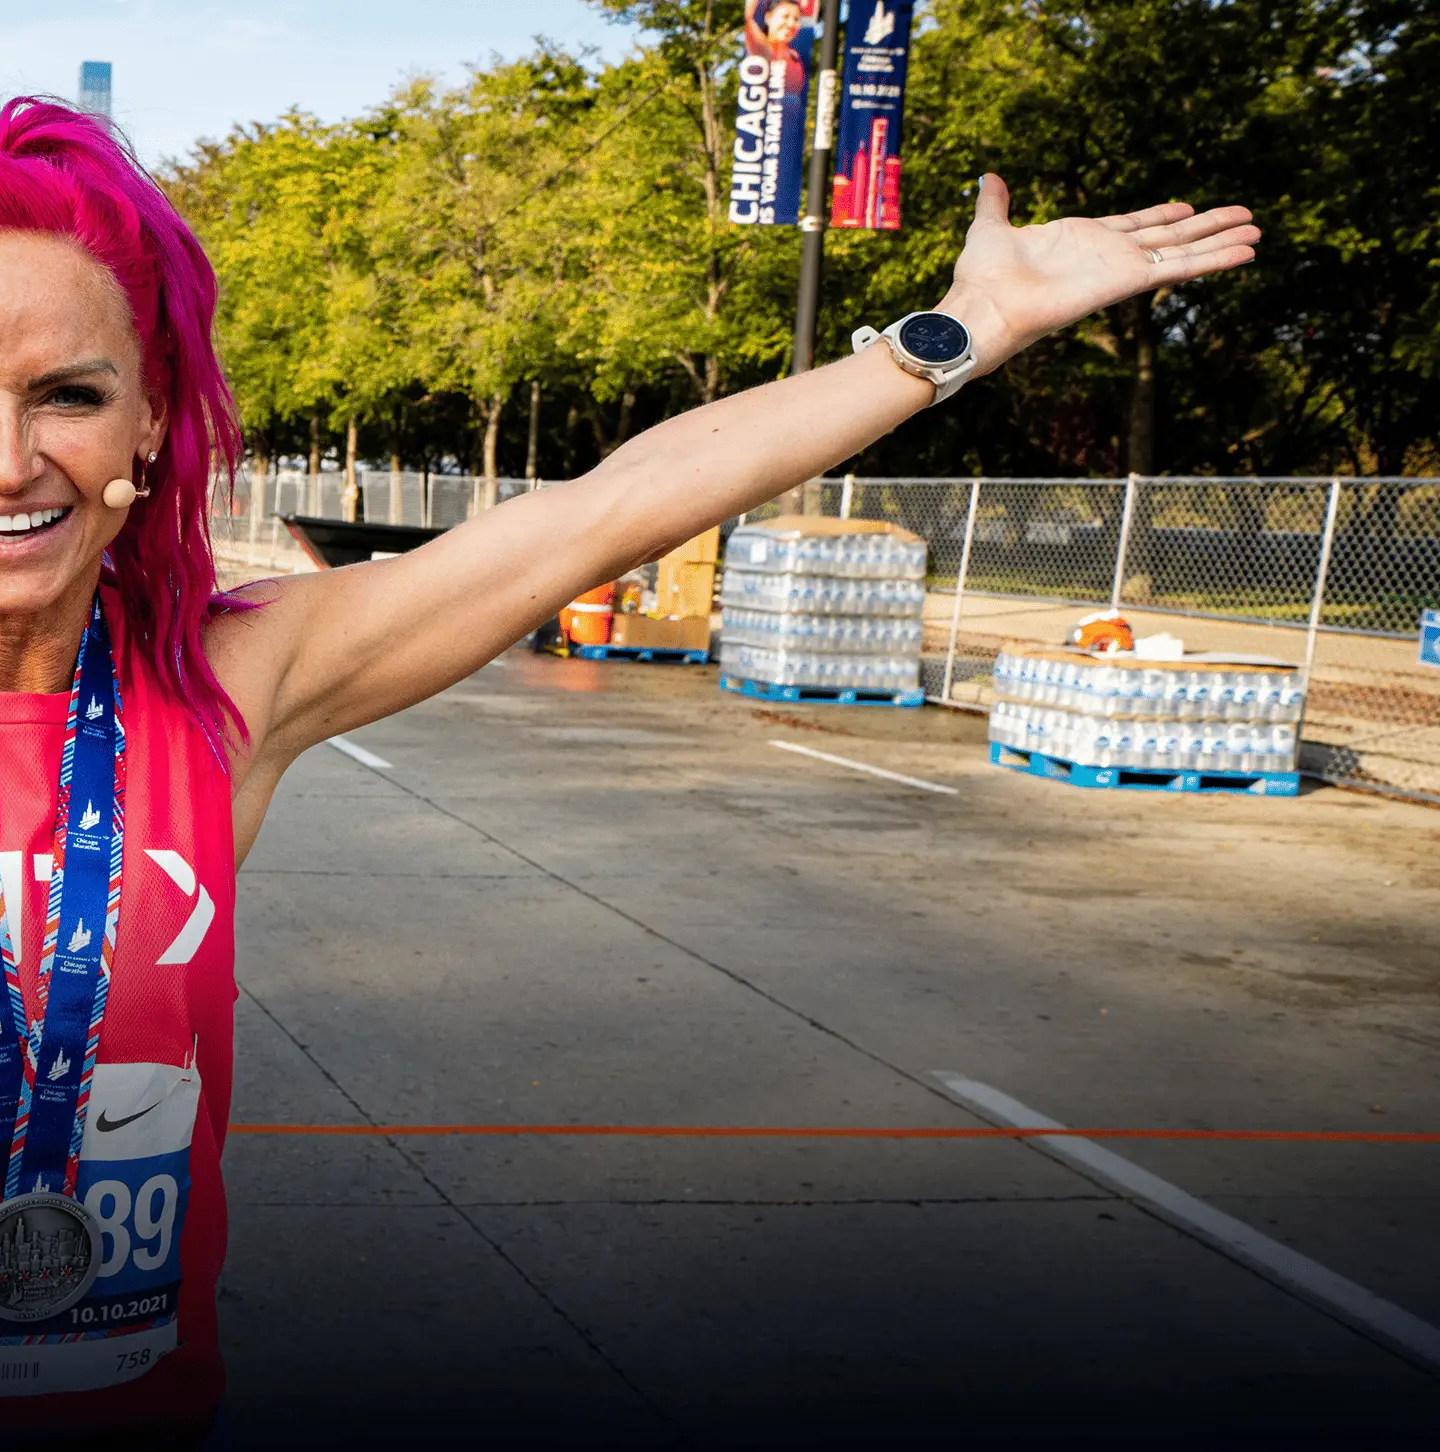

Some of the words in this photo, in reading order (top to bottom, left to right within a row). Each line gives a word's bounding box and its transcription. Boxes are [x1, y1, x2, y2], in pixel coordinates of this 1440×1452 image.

[763, 101, 784, 155] START
[728, 55, 770, 225] CHICAGO
[760, 158, 779, 205] YOUR
[759, 206, 776, 225] IS
[73, 842, 101, 851] Marathon
[76, 837, 99, 846] Chicago
[60, 966, 88, 975] Marathon
[63, 960, 87, 969] Chicago
[70, 1294, 168, 1325] 10.10.2021
[117, 1348, 151, 1371] 758
